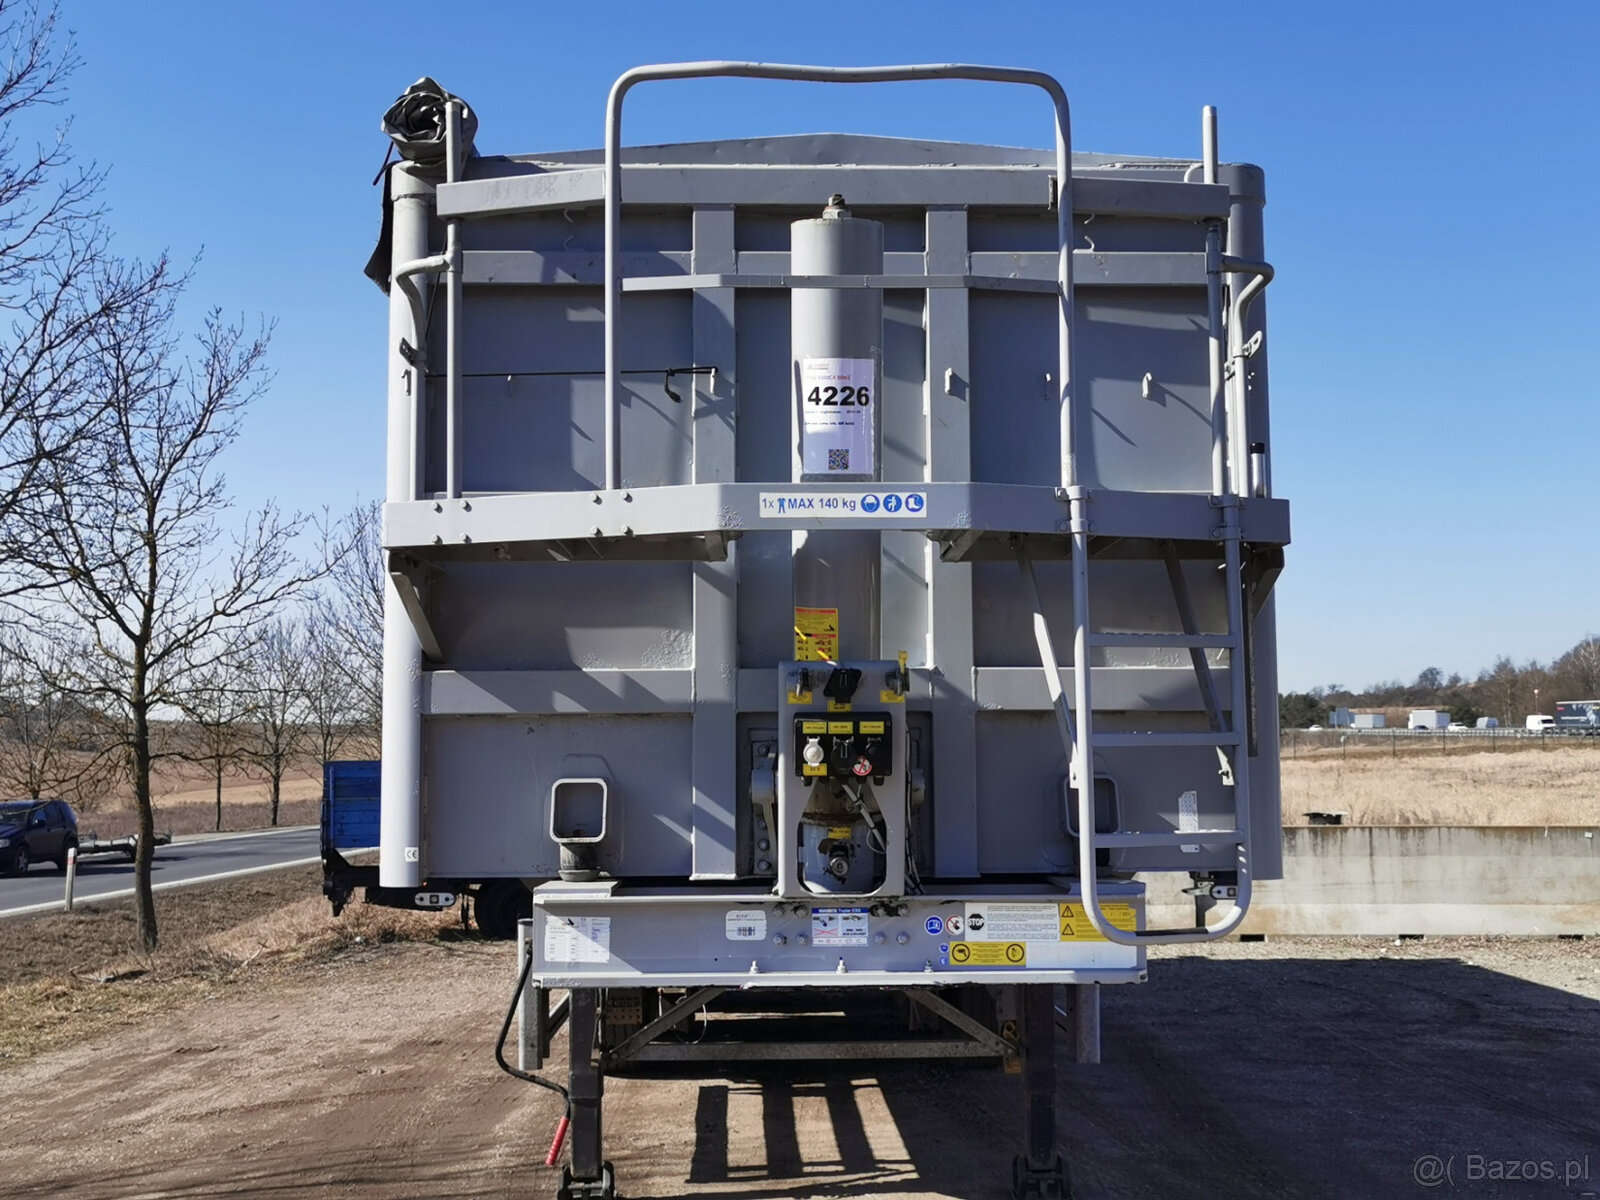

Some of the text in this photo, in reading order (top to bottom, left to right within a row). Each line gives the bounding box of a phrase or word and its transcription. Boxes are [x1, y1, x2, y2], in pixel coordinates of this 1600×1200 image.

[807, 385, 870, 407] 4226
[761, 497, 856, 512] 1x MAX 140 kg
[406, 849, 418, 859] CE
[967, 918, 985, 926] STOP
